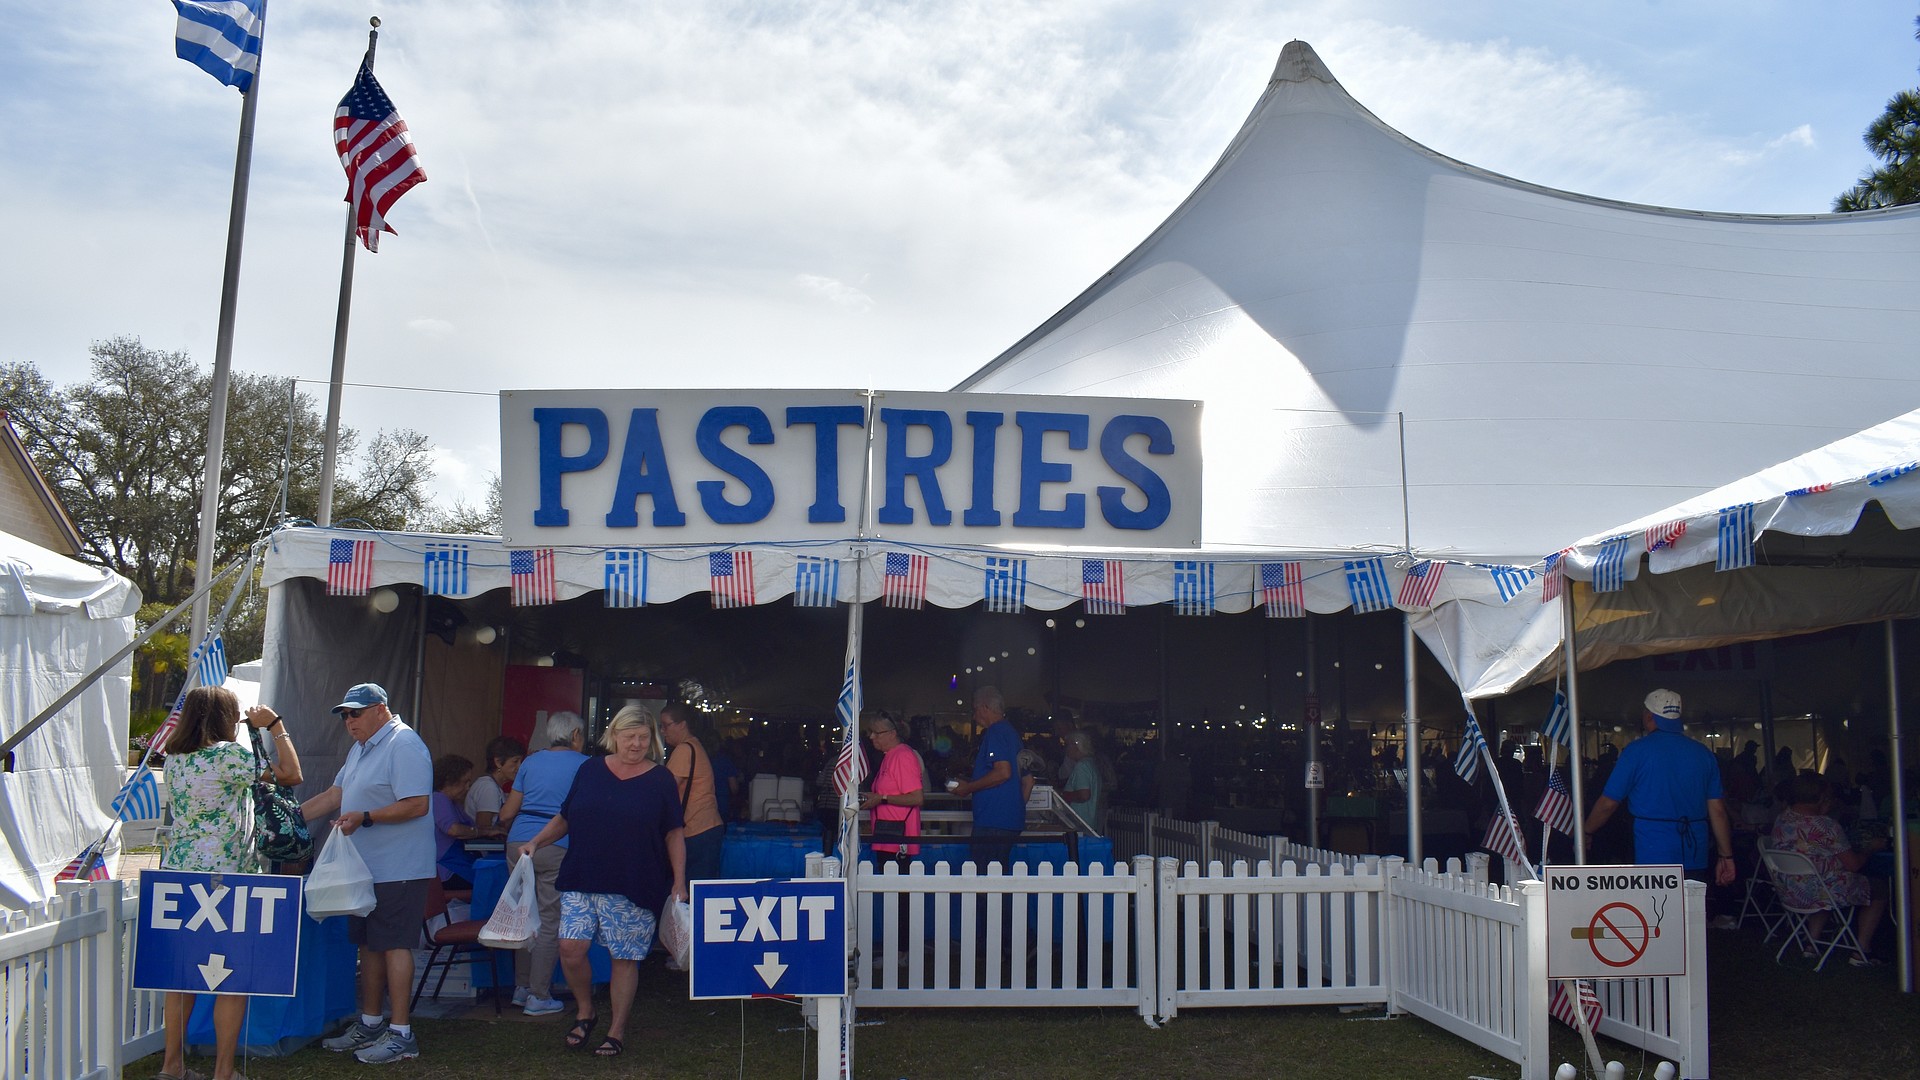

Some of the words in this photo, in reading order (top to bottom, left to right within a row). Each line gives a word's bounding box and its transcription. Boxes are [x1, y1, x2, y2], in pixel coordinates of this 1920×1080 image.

[532, 405, 1175, 530] PASTRIES
[1551, 876, 1580, 890] NO
[1586, 874, 1678, 890] SMOKING
[151, 882, 287, 934] EXIT
[704, 896, 835, 943] EXIT
